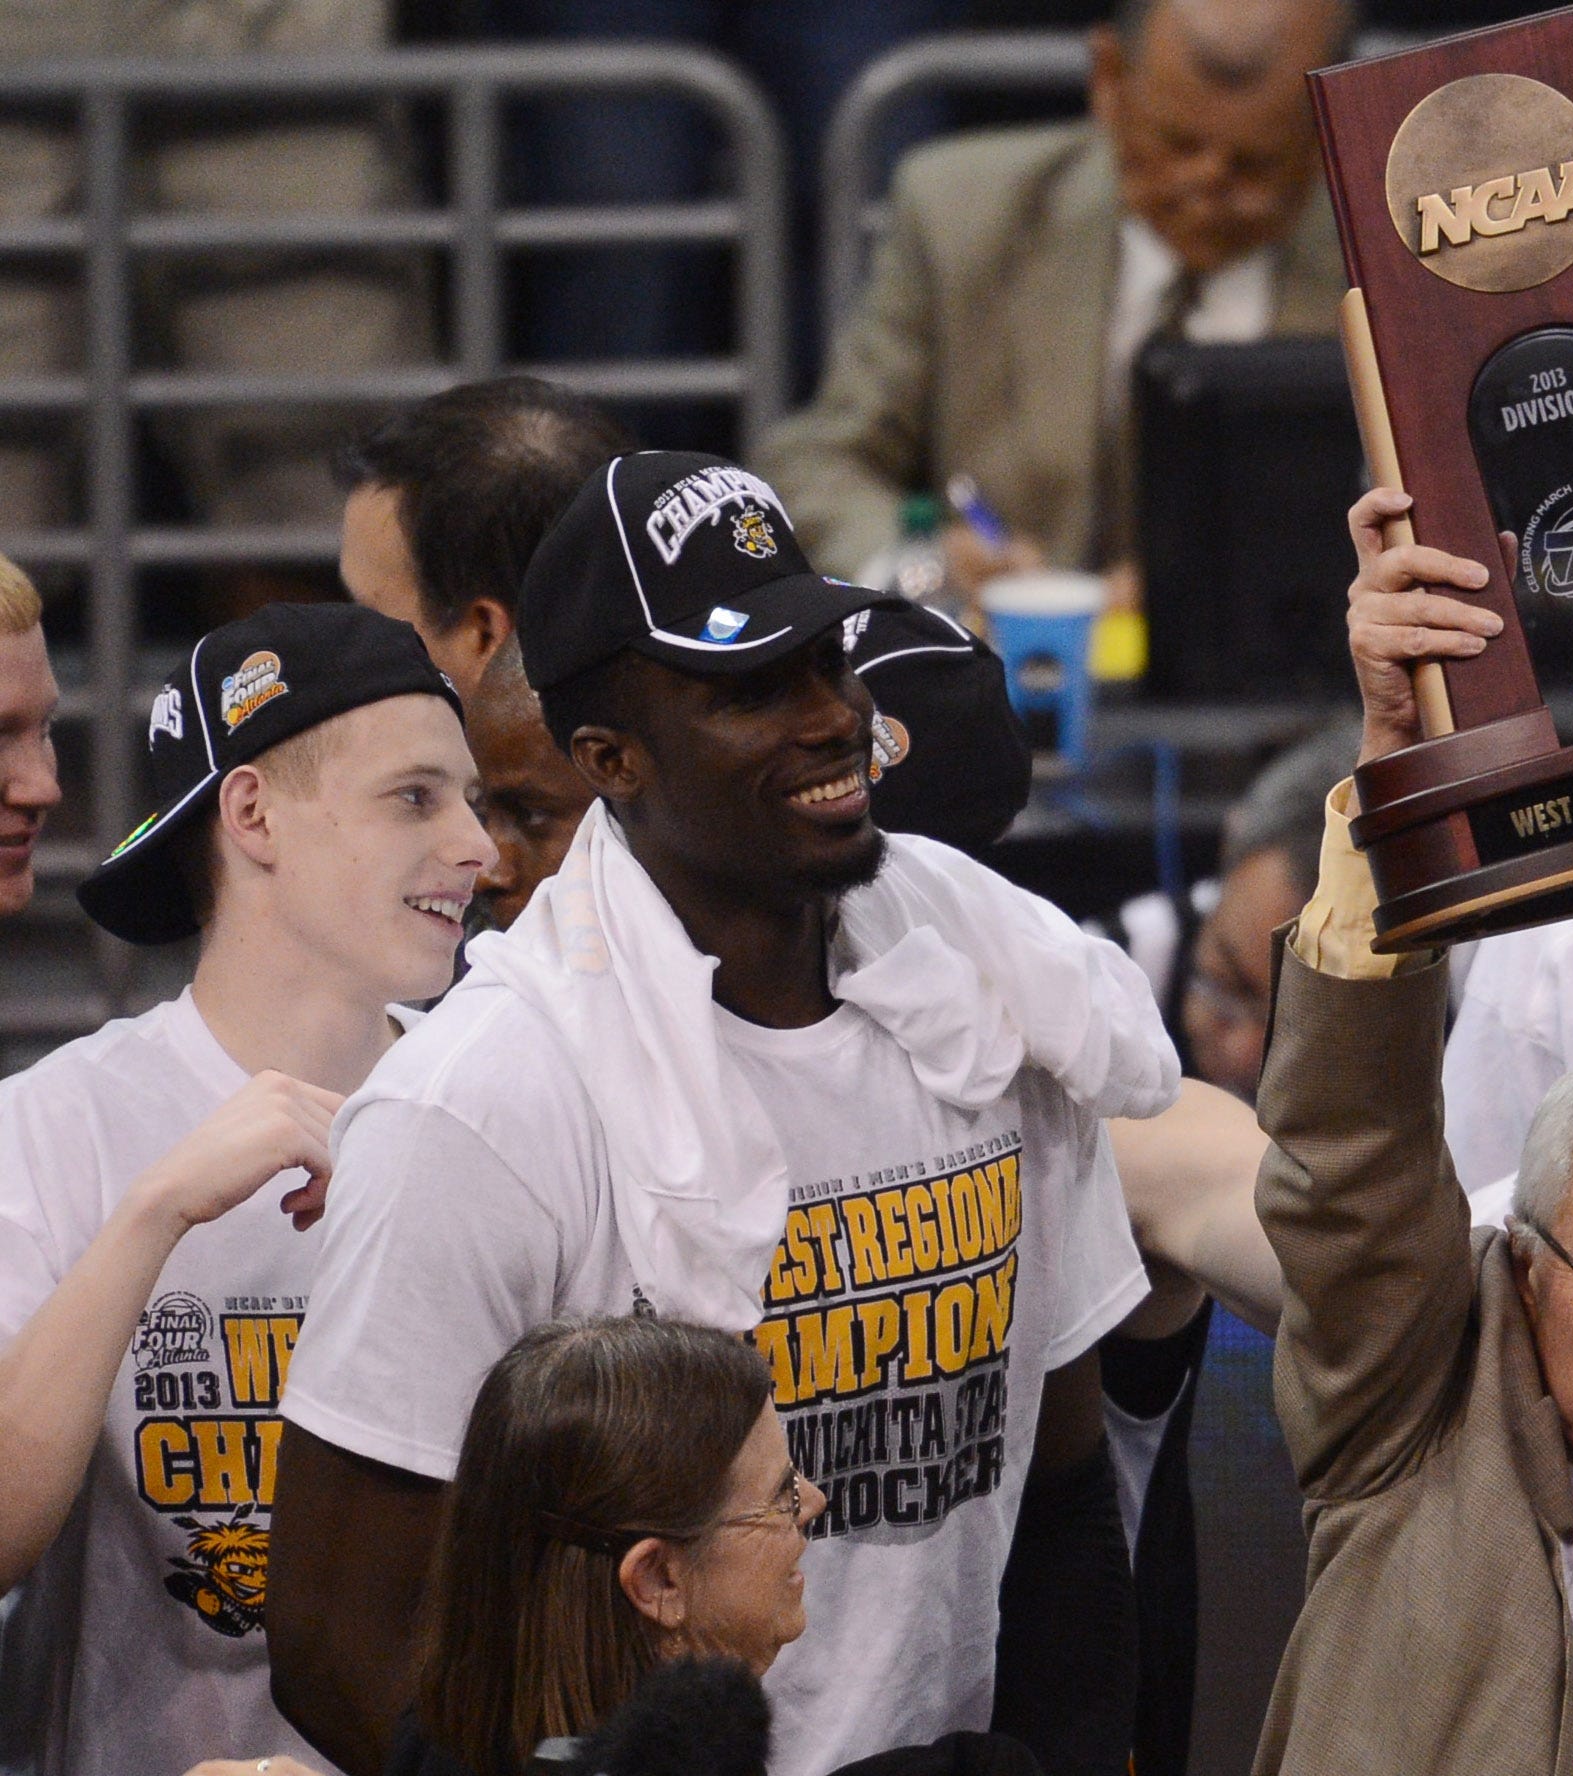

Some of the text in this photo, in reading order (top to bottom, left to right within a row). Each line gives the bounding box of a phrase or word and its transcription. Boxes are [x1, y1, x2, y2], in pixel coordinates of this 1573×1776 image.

[1529, 367, 1567, 394] 2013
[1521, 514, 1541, 593] CELEBRATING
[1536, 484, 1573, 516] MARCH
[1510, 796, 1573, 838] WEST
[760, 1200, 844, 1306] EST
[132, 1324, 202, 1354] FOUR
[149, 1311, 202, 1330] FINAL
[148, 1346, 210, 1368] Atlanta
[134, 1371, 222, 1411] 2013
[786, 1391, 948, 1482] WICHITA
[803, 1436, 1006, 1541] HOCKER
